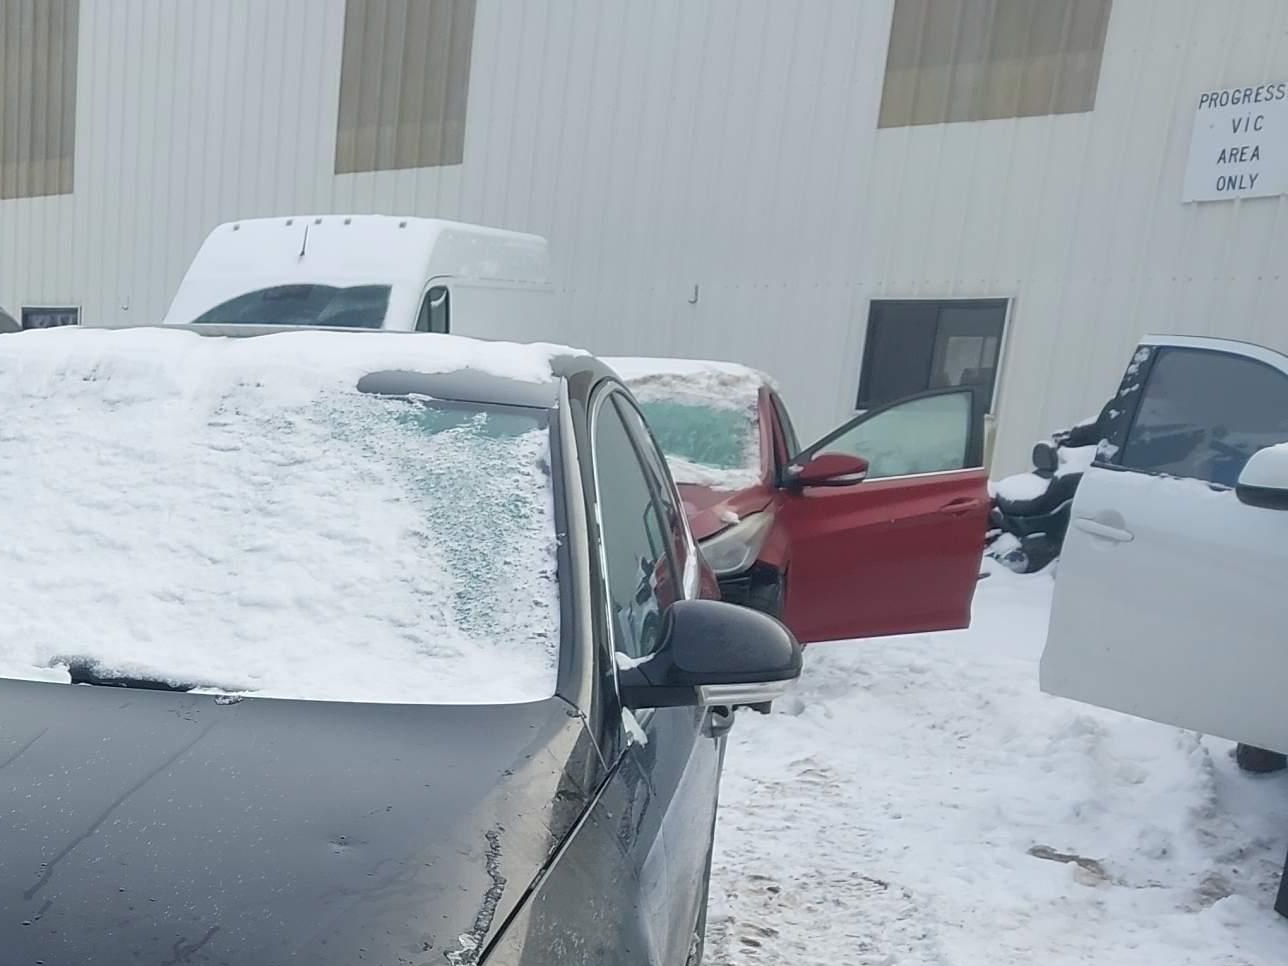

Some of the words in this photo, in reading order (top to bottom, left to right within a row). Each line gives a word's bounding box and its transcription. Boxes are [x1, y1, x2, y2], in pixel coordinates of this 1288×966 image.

[1232, 115, 1264, 134] VIC
[1216, 145, 1261, 165] AREA
[1216, 173, 1260, 191] ONLY
